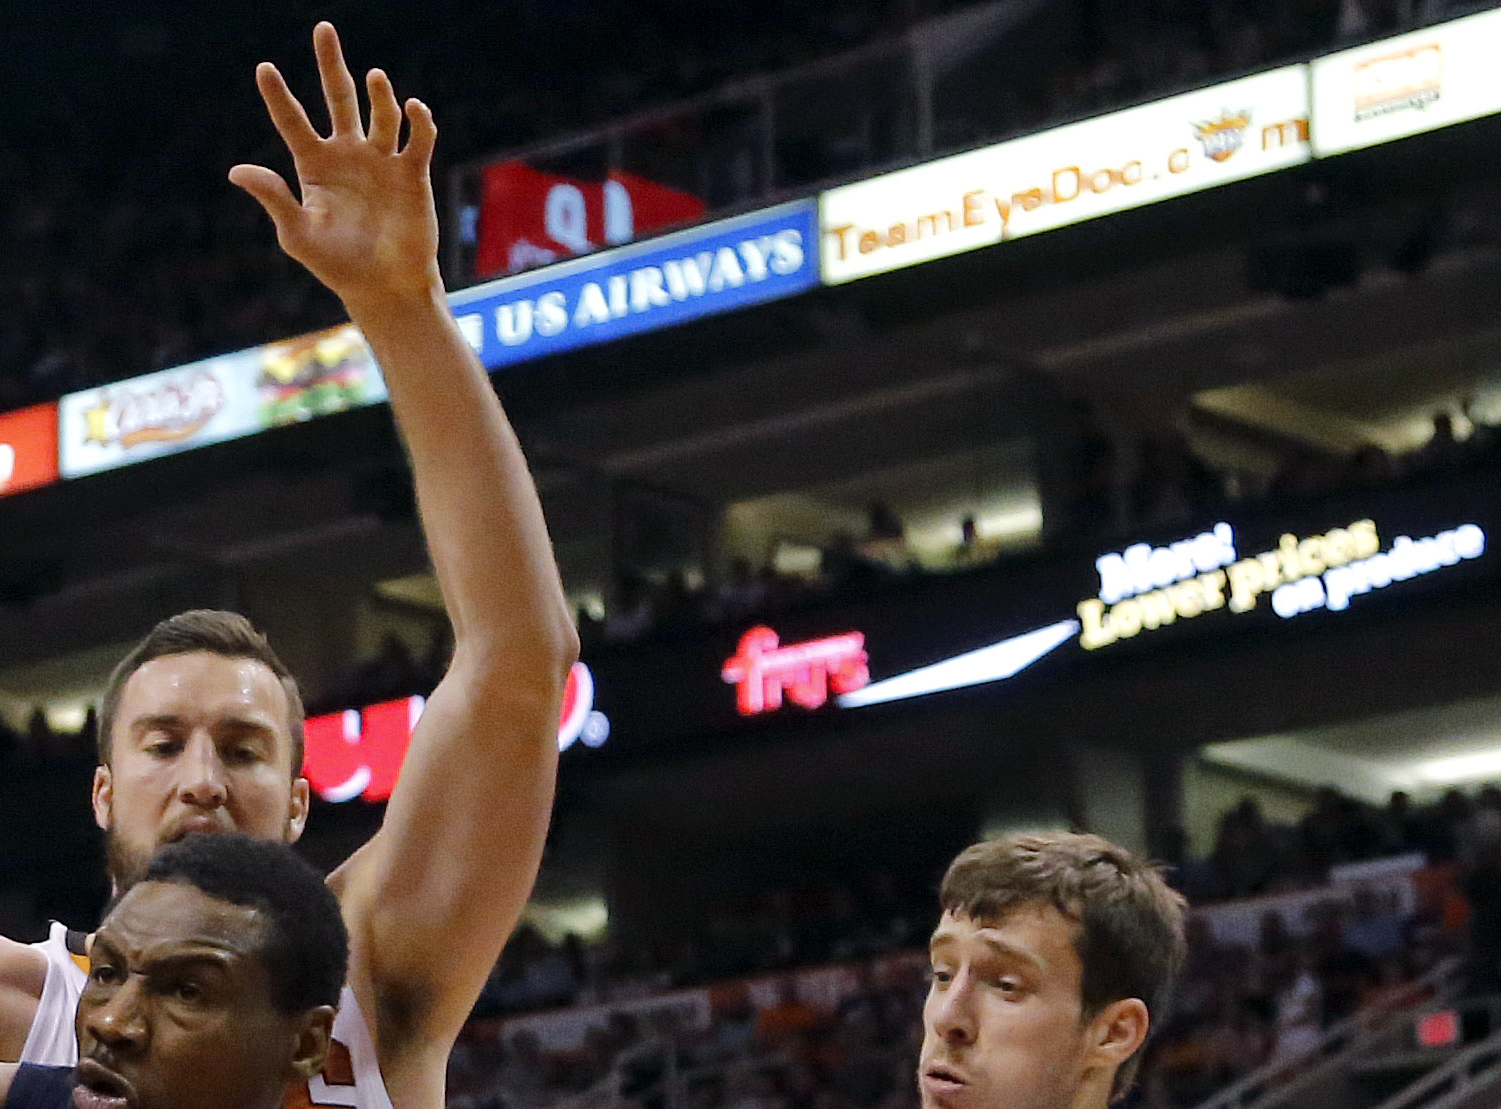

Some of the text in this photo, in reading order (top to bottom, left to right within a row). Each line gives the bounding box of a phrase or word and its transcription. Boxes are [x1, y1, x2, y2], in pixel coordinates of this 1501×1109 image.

[495, 292, 568, 347] US
[574, 229, 804, 328] AIRWAYS
[1076, 518, 1380, 651] Lower prices
